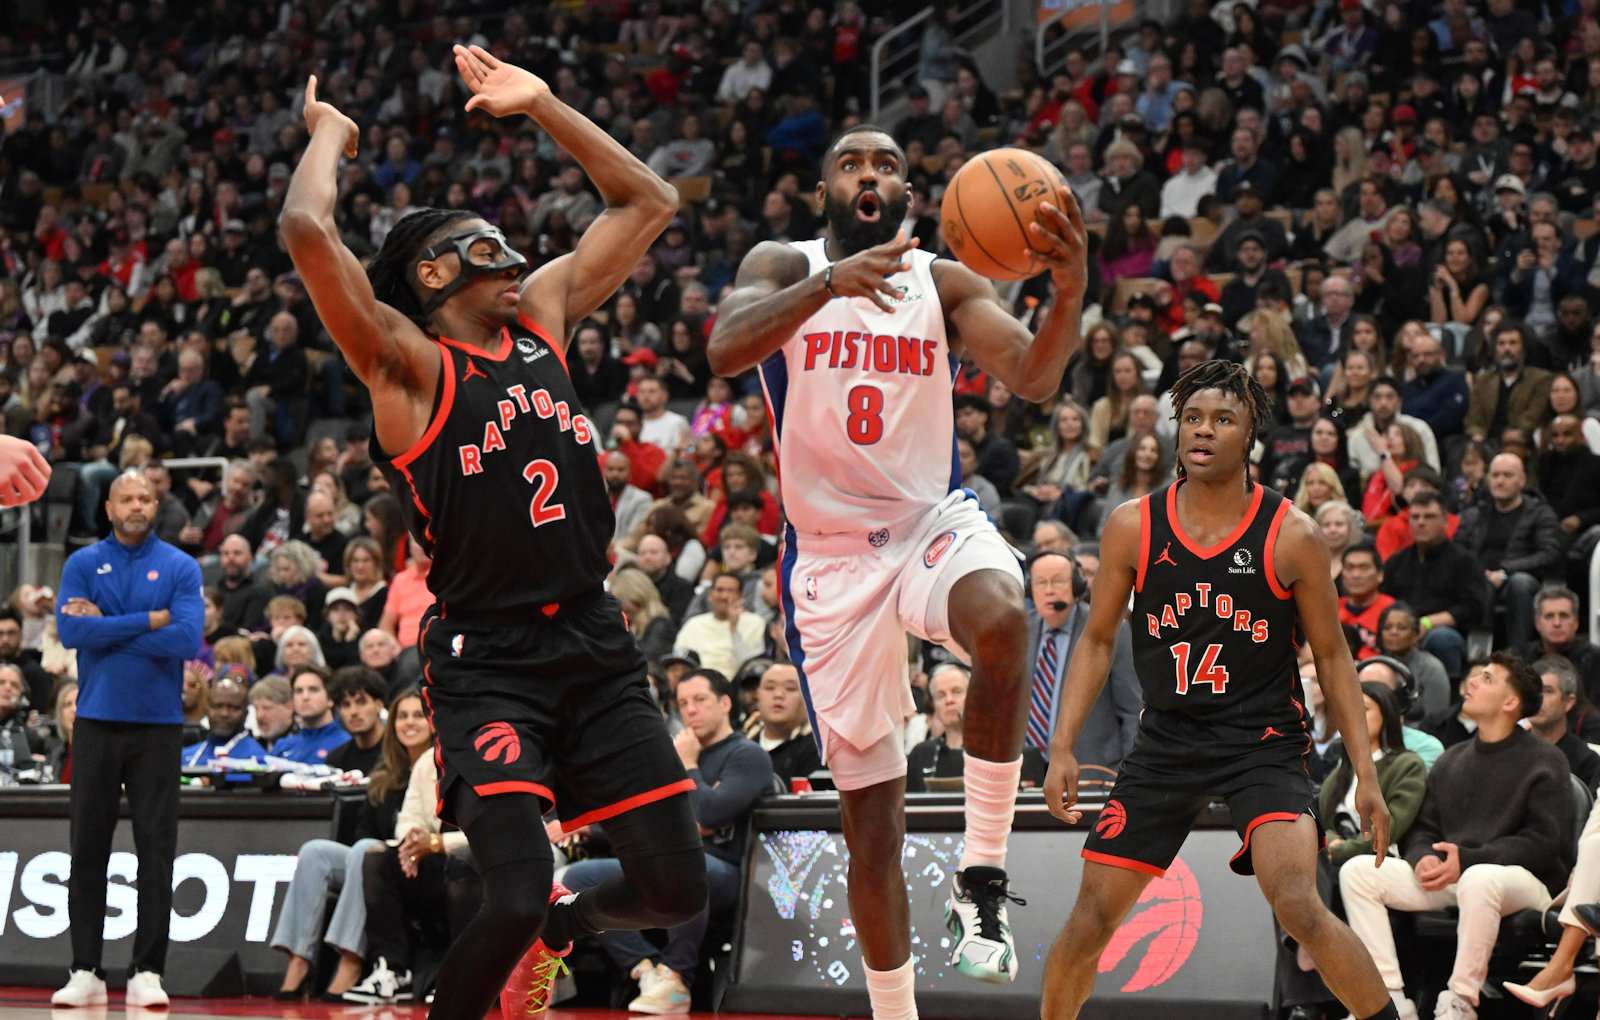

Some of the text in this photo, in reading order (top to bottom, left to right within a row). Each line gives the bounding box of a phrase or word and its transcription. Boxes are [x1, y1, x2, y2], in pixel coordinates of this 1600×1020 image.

[804, 331, 937, 376] PISTONS
[459, 384, 591, 476] RAPTORS
[847, 385, 884, 445] 8
[523, 459, 566, 527] 2
[1228, 566, 1256, 574] Sun Life
[1147, 583, 1268, 643] RAPTORS
[1170, 642, 1229, 695] 14
